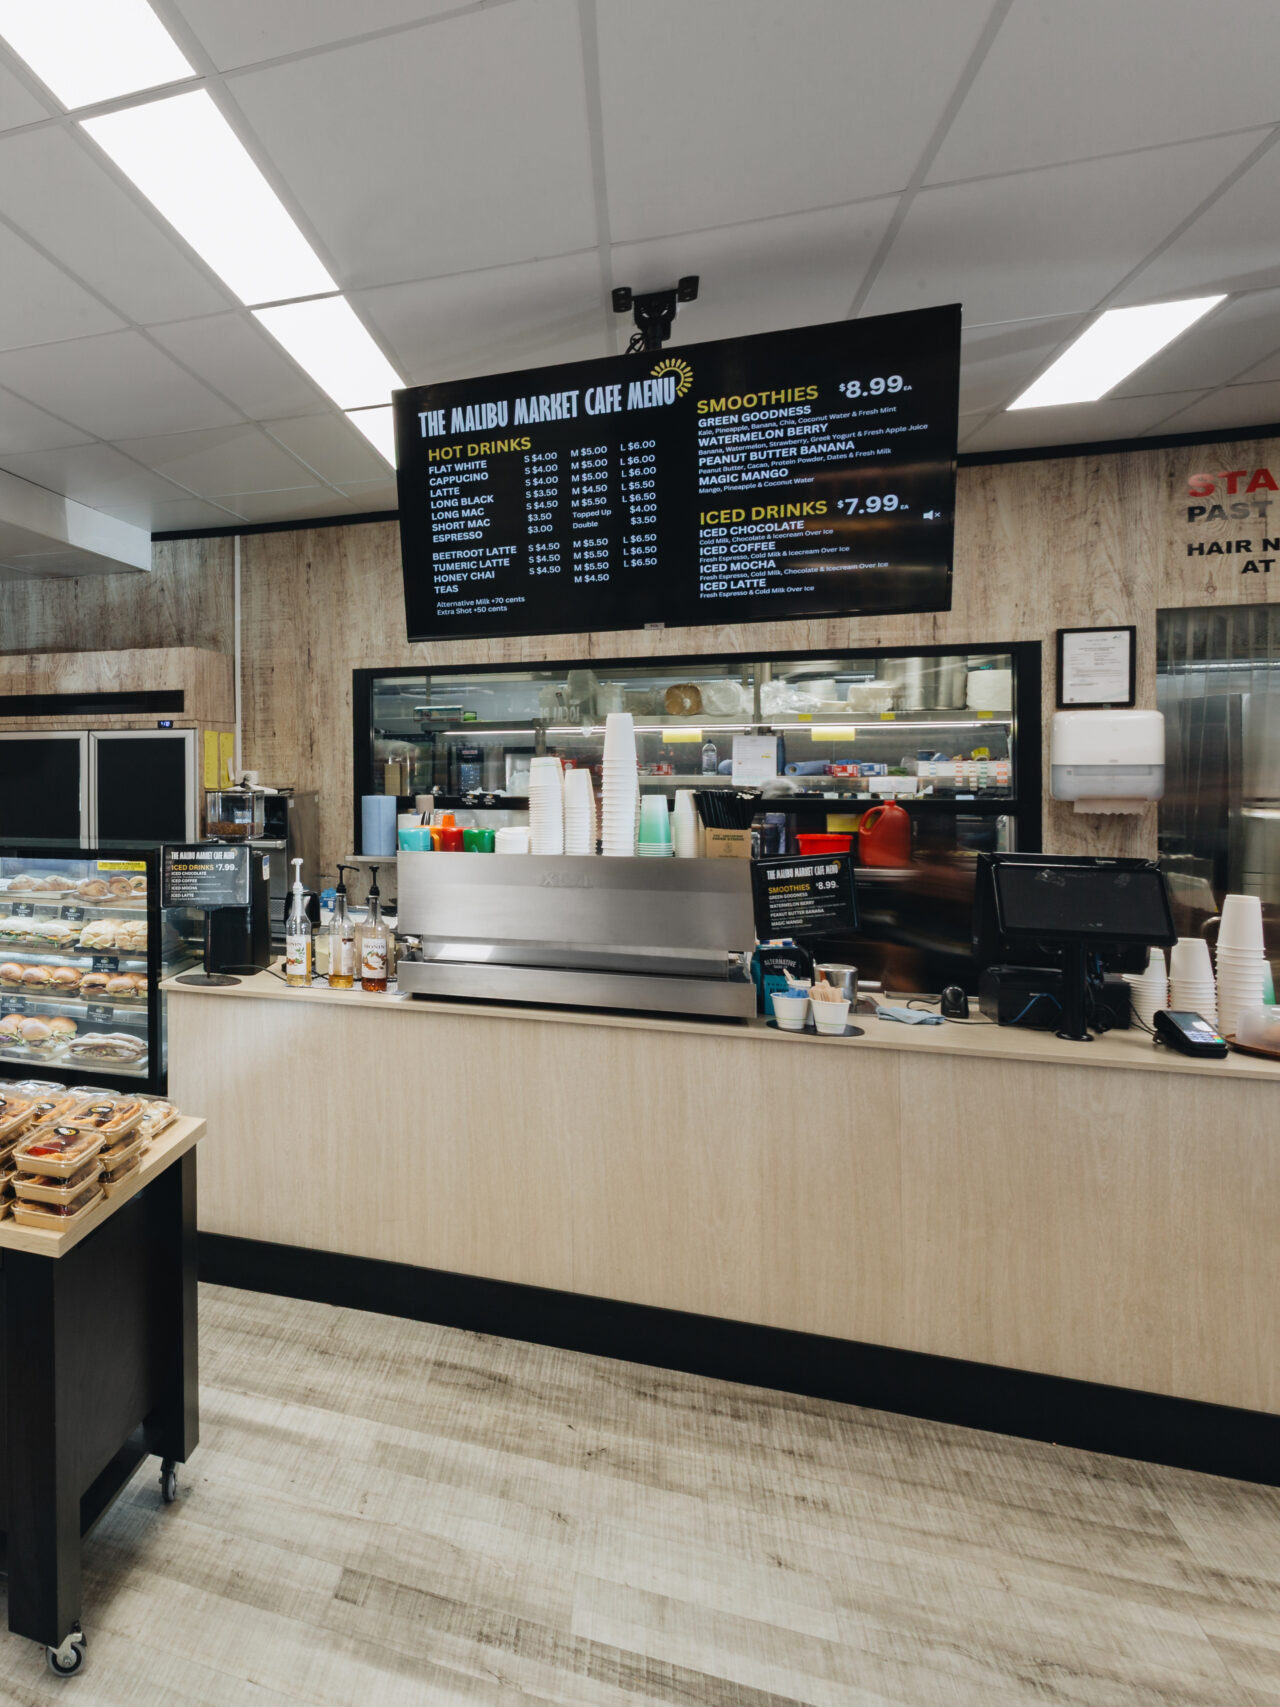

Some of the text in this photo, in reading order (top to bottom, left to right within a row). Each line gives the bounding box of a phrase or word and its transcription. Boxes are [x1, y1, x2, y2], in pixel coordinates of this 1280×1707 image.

[698, 386, 818, 413] SMOOTHIES
[839, 375, 902, 398] $8.99
[418, 376, 676, 437] THE MALIBU MARKET CAFE MENU
[698, 415, 738, 427] GREEN
[742, 405, 811, 422] GOODNESS
[698, 429, 783, 447] WATERMELON
[787, 423, 828, 436] BERRY
[429, 437, 531, 461] HOT DRINKS
[429, 440, 655, 474] FLAT WHITE $4.00 $5.00 $6.00
[699, 453, 747, 466] PEANUT
[750, 448, 797, 460] BUTTER
[801, 441, 854, 454] BANANA
[429, 455, 655, 486] CAPPUCINO $4.00 $5.00 $6.00
[430, 467, 656, 497] LATTE $4.00 $5.00 $6.00
[699, 468, 788, 485] MAGIC MANGO
[431, 480, 654, 509] LONG BLACK $3.50 $4.50 $5.50
[432, 492, 656, 520] LONG MAC $4.50 $5.50 $6.50
[432, 521, 465, 531] SHORT
[468, 519, 490, 528] MAC
[528, 513, 552, 522] $3.50
[573, 510, 599, 518] Topped
[630, 504, 656, 514] $4.00
[701, 509, 745, 525] ICED
[752, 501, 827, 520] DRINKS
[838, 495, 898, 515] $7.99
[1187, 500, 1273, 522] PAST
[433, 531, 482, 543] ESPRESSO
[528, 525, 552, 534] $3.00
[631, 516, 656, 525] $3.50
[700, 528, 727, 538] ICED
[730, 521, 804, 535] CHOCOLATE
[433, 534, 656, 560] BEETROOT LATTE $4.50 $5.50 $6.50
[433, 546, 657, 571] TUMERIC LATTE $4.50 $5.50 $6.50
[700, 542, 775, 555] ICED COFFEE
[1187, 540, 1253, 556] HAIR
[434, 558, 657, 583] HONEY CHAI $4.50 $5.50 $6.50
[700, 564, 727, 573] ICED
[731, 560, 776, 571] MOCHA
[1241, 559, 1276, 574] AT
[434, 574, 609, 594] TEAS $4.50
[700, 582, 727, 591] ICED
[731, 579, 766, 589] LATTE
[768, 883, 811, 894] SMOOTHIES
[763, 958, 798, 968] ALTERNATIVE
